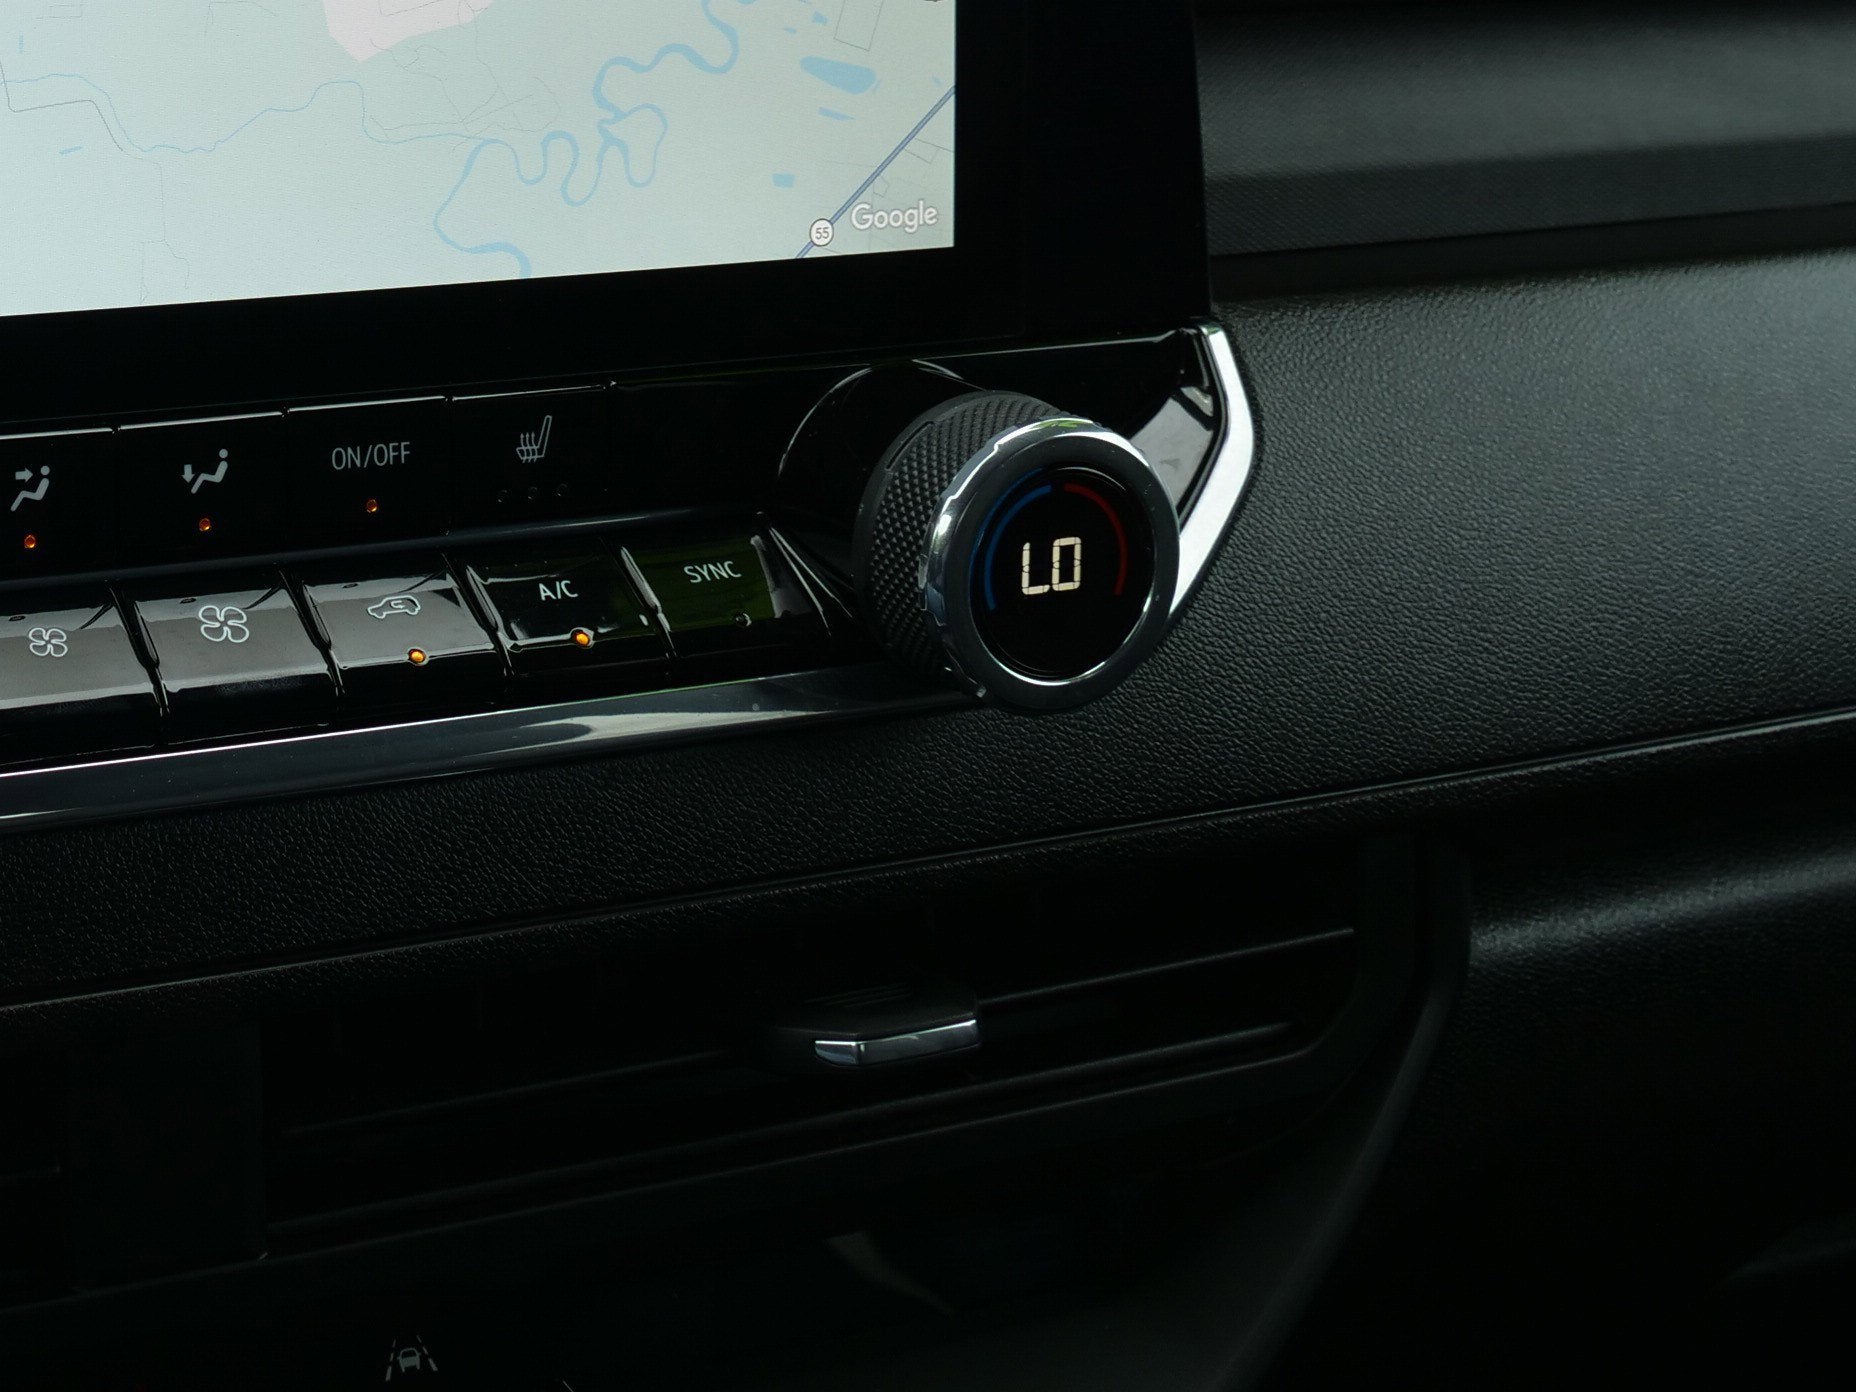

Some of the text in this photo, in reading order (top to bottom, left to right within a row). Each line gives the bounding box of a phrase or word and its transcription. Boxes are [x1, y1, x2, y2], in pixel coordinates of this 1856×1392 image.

[850, 200, 939, 234] Google
[814, 227, 830, 240] 55
[331, 441, 411, 471] ON/OFF
[683, 560, 743, 584] SYNC
[538, 580, 579, 602] A/C
